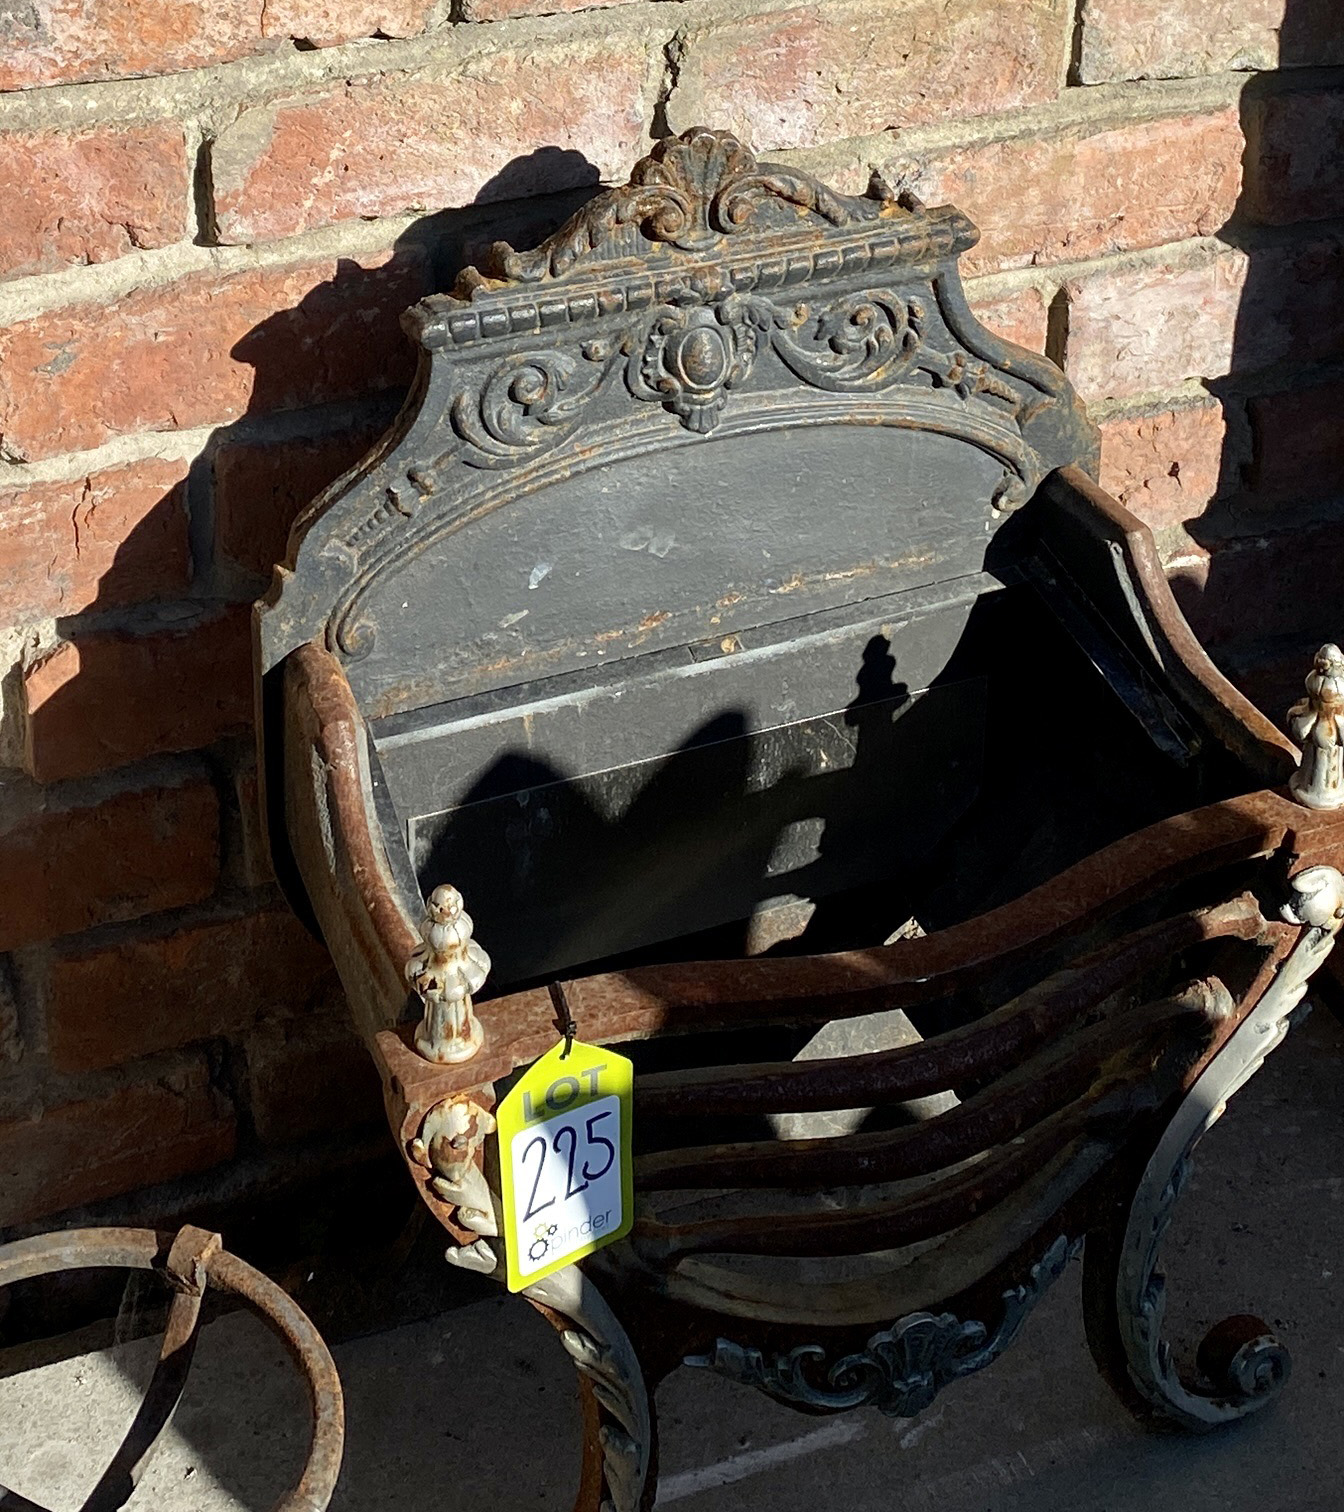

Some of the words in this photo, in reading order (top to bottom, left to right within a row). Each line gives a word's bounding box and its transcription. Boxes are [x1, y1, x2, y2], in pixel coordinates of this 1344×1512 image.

[522, 1064, 607, 1123] LOT
[521, 1111, 616, 1223] 225
[551, 1209, 613, 1256] pinder
